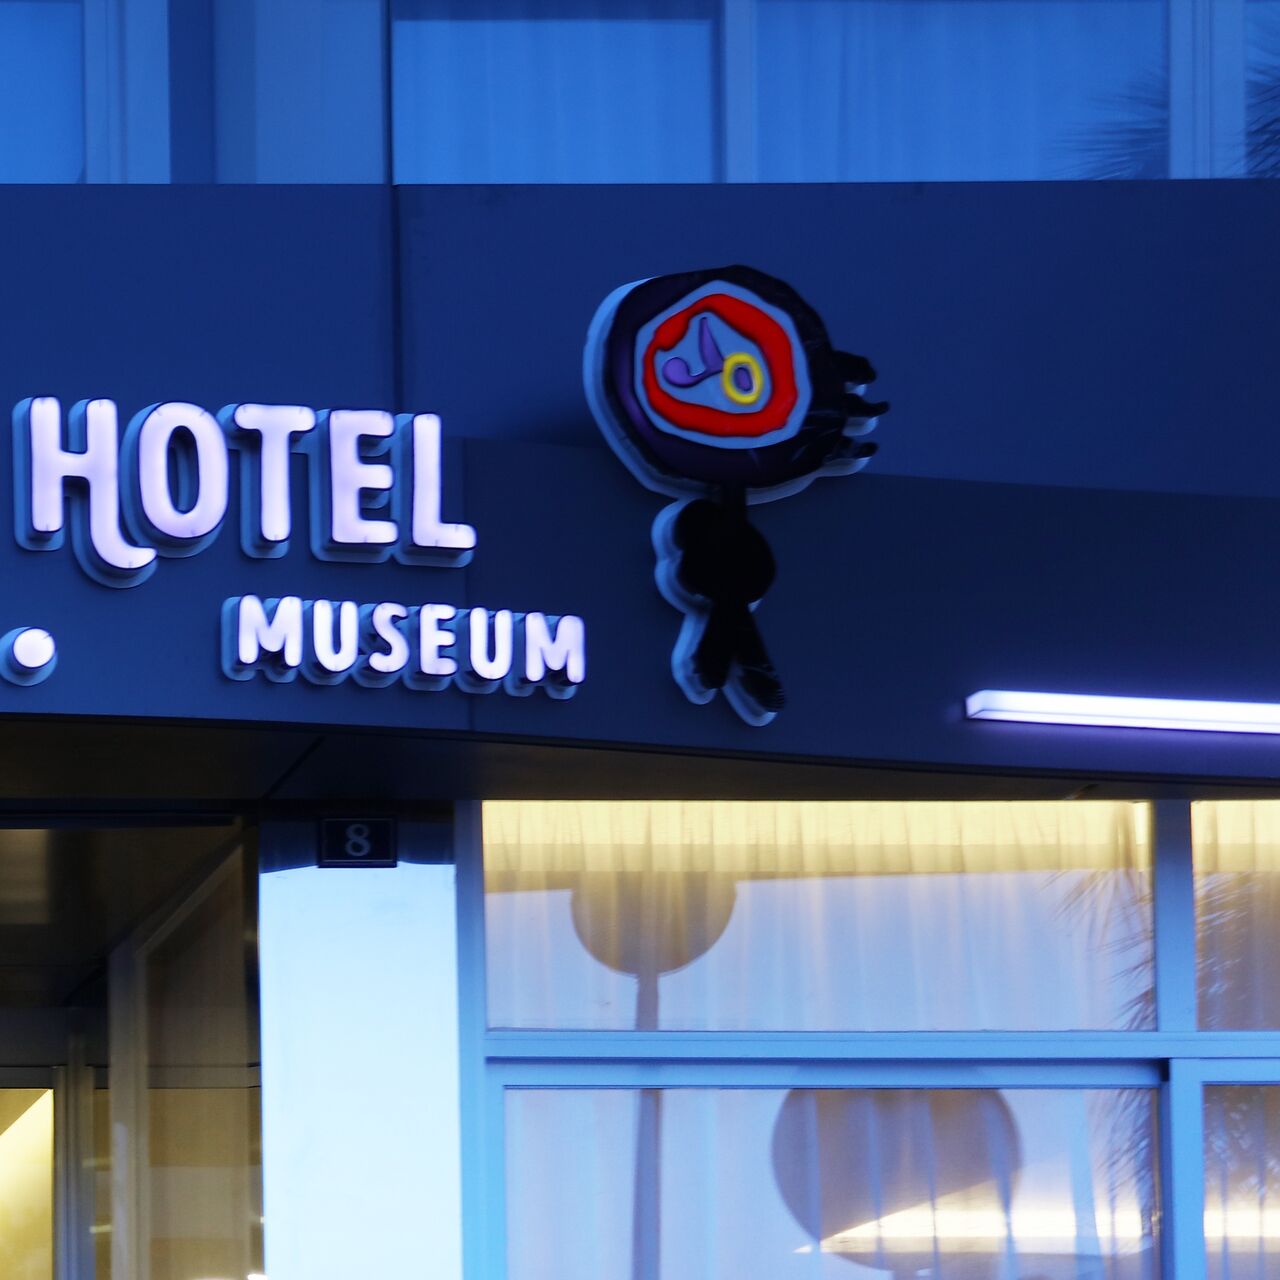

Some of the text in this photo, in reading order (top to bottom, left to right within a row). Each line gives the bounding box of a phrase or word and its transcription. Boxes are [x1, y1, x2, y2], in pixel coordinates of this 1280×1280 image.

[28, 396, 477, 570] HOTEL
[235, 594, 586, 685] MUSEUM
[345, 823, 371, 857] 8
